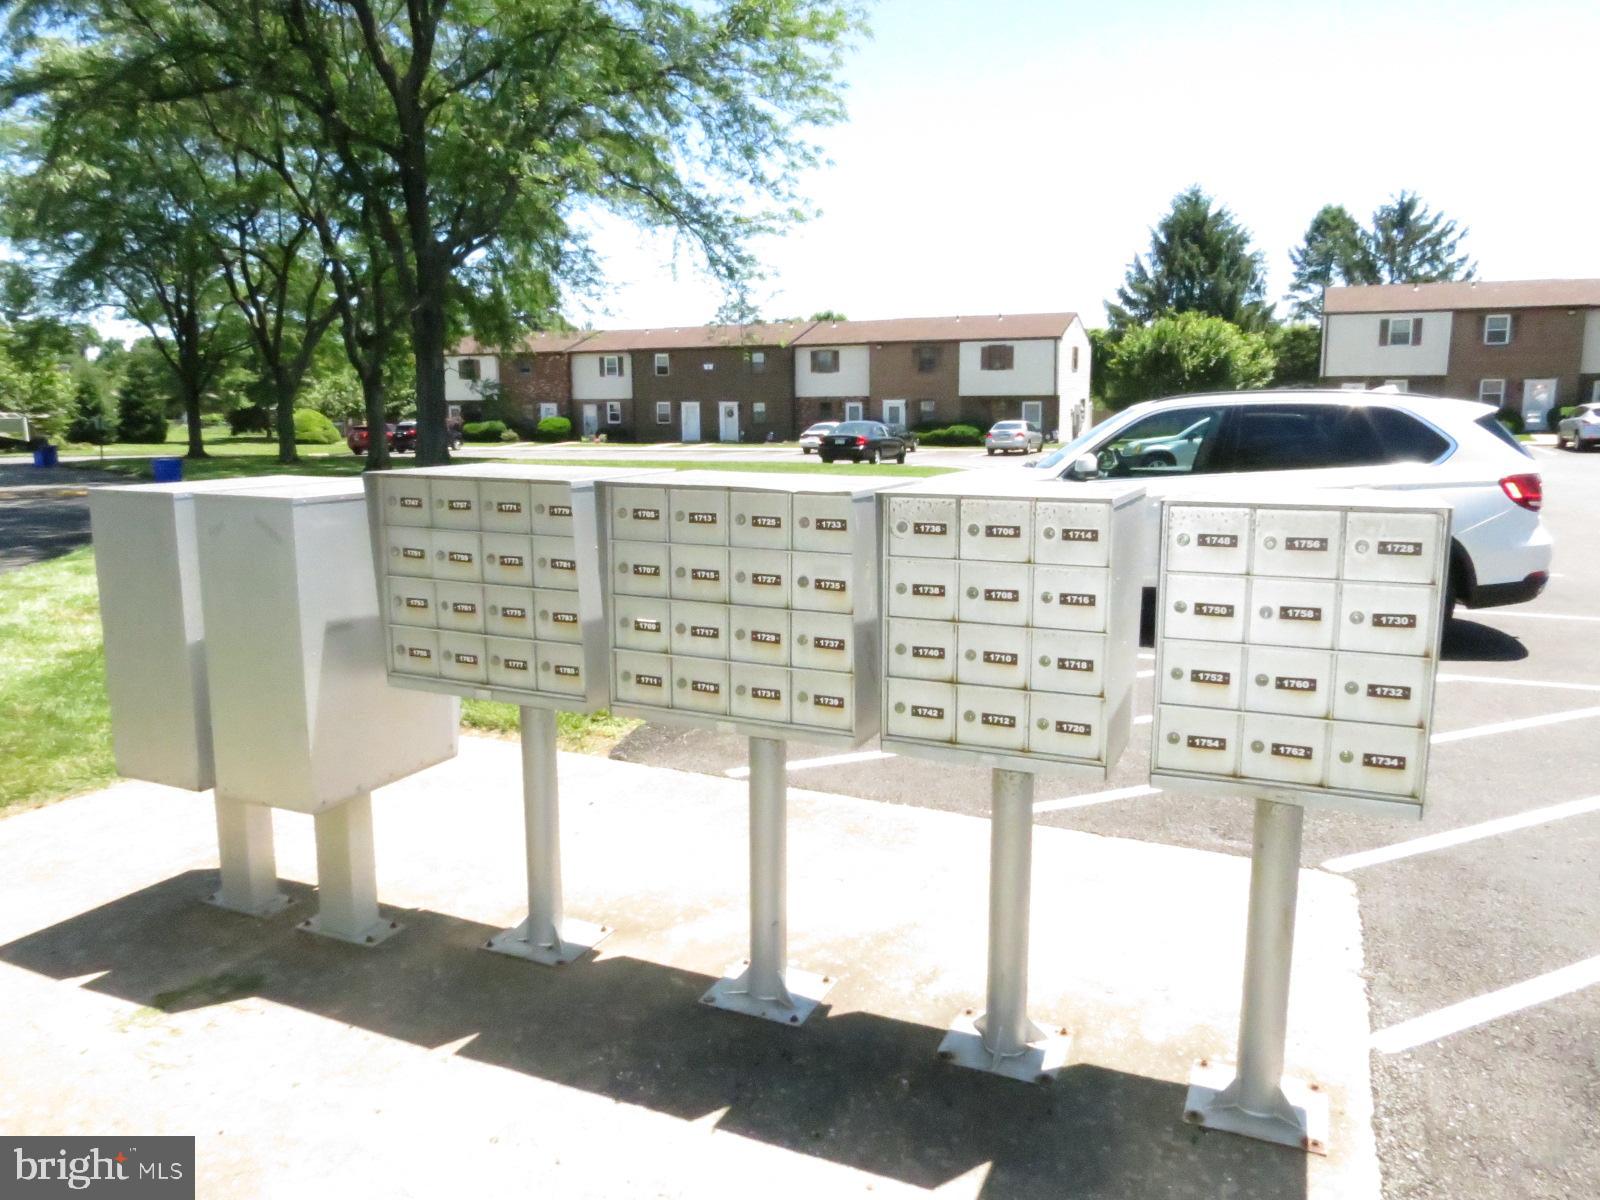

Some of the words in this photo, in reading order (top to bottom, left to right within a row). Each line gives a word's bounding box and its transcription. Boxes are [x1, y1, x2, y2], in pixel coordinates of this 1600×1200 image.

[694, 514, 712, 522] 1713
[1293, 541, 1320, 549] 1756
[1386, 544, 1414, 553] 1728
[638, 566, 655, 574] 1707
[697, 571, 715, 579] 1715
[757, 575, 776, 583] 1727
[820, 581, 840, 589] 1735
[1066, 596, 1089, 604] 1716
[1287, 610, 1314, 618] 1758
[1380, 617, 1408, 625] 1730
[696, 628, 714, 636] 1717
[990, 654, 1011, 662] 1710
[1065, 661, 1087, 669] 1718
[1198, 673, 1223, 681] 1752
[1283, 680, 1310, 688] 1760
[1375, 688, 1402, 696] 1732
[917, 708, 938, 716] 1742
[988, 716, 1010, 724] 1712
[1062, 724, 1084, 733] 1720
[1194, 739, 1219, 747] 1754
[1279, 747, 1305, 756] 1762
[1371, 757, 1398, 766] 1734
